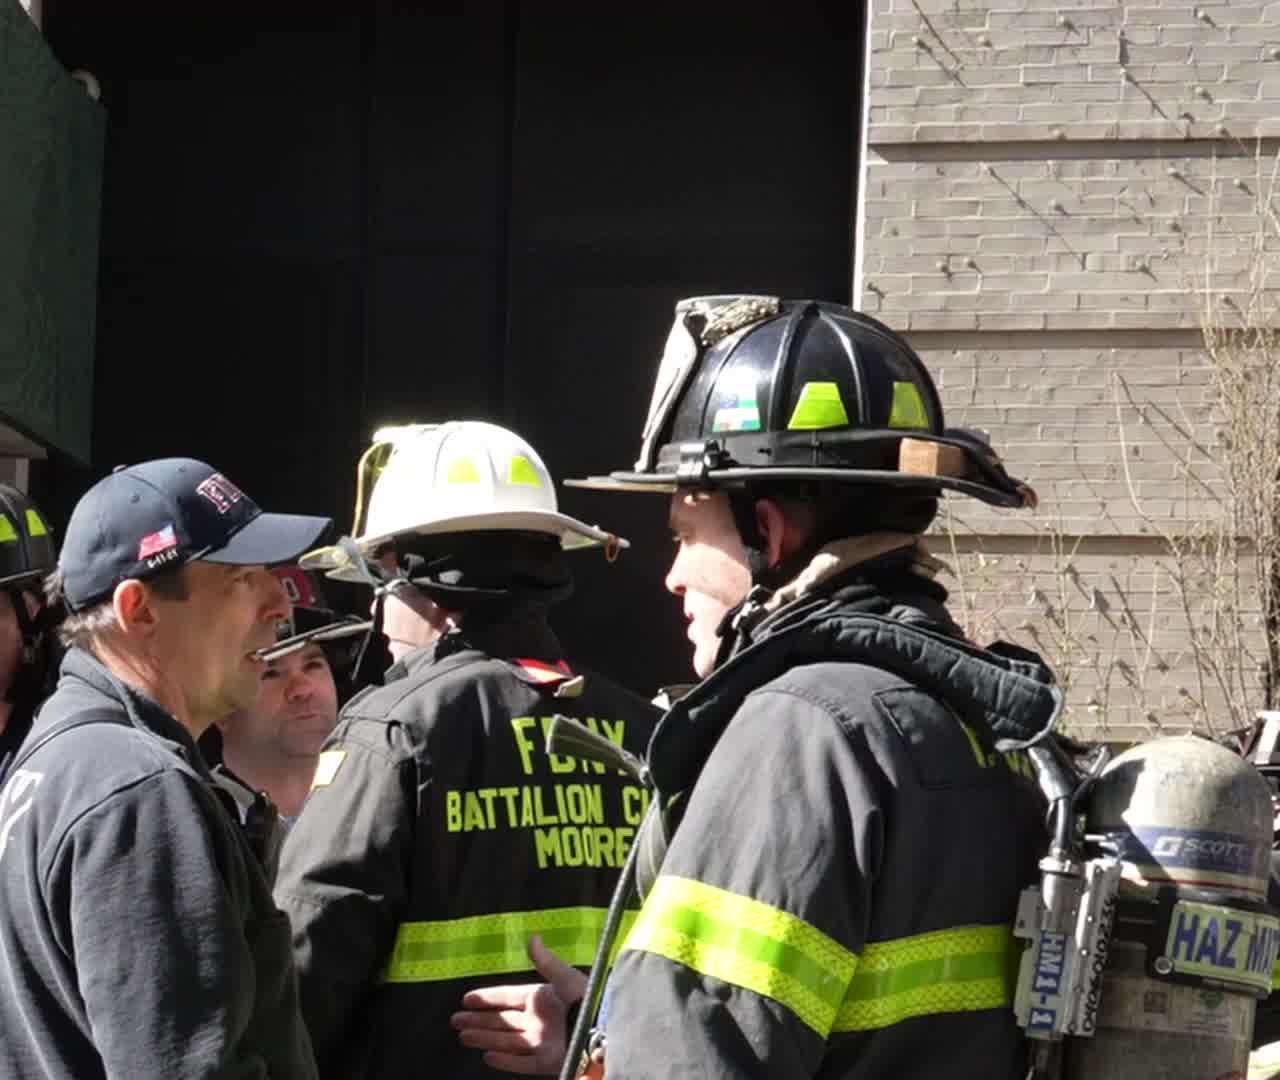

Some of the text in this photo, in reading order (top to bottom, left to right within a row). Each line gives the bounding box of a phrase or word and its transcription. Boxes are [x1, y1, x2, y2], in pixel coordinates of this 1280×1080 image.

[446, 783, 604, 833] BATTALION
[534, 827, 635, 869] MOORE
[1174, 911, 1244, 969] HAZ
